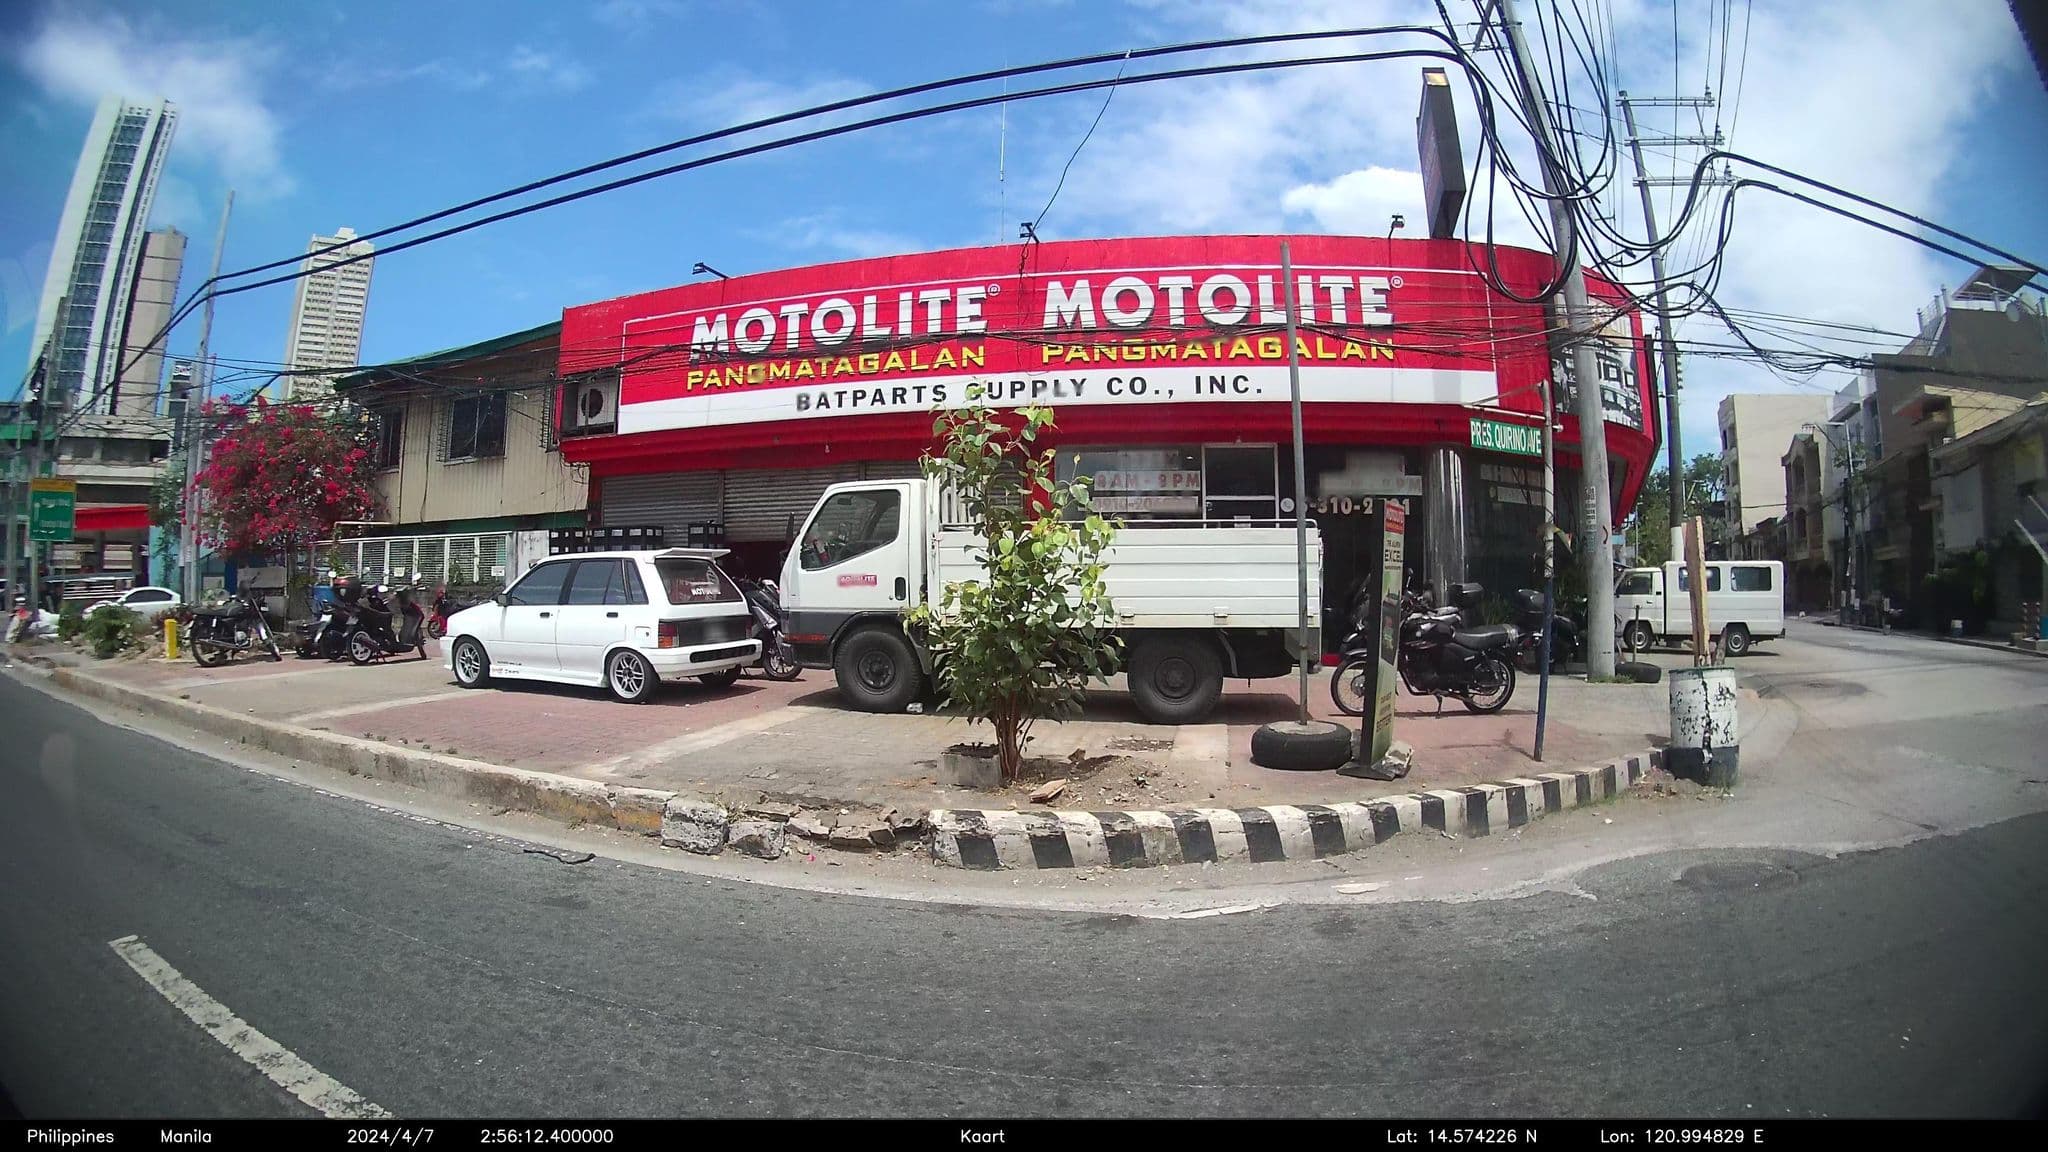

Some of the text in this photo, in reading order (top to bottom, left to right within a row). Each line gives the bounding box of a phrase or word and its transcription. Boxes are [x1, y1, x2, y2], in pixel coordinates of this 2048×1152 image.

[689, 274, 1393, 362] MOTOLITE MOTOLITE
[687, 337, 1395, 391] PANGMATAGALAN PANGMATAGALAN
[796, 384, 947, 411] BATPARTS
[1106, 376, 1174, 400] CO.,
[1195, 374, 1263, 395] INC.
[1470, 420, 1542, 454] PRES. QUIRINO AVE
